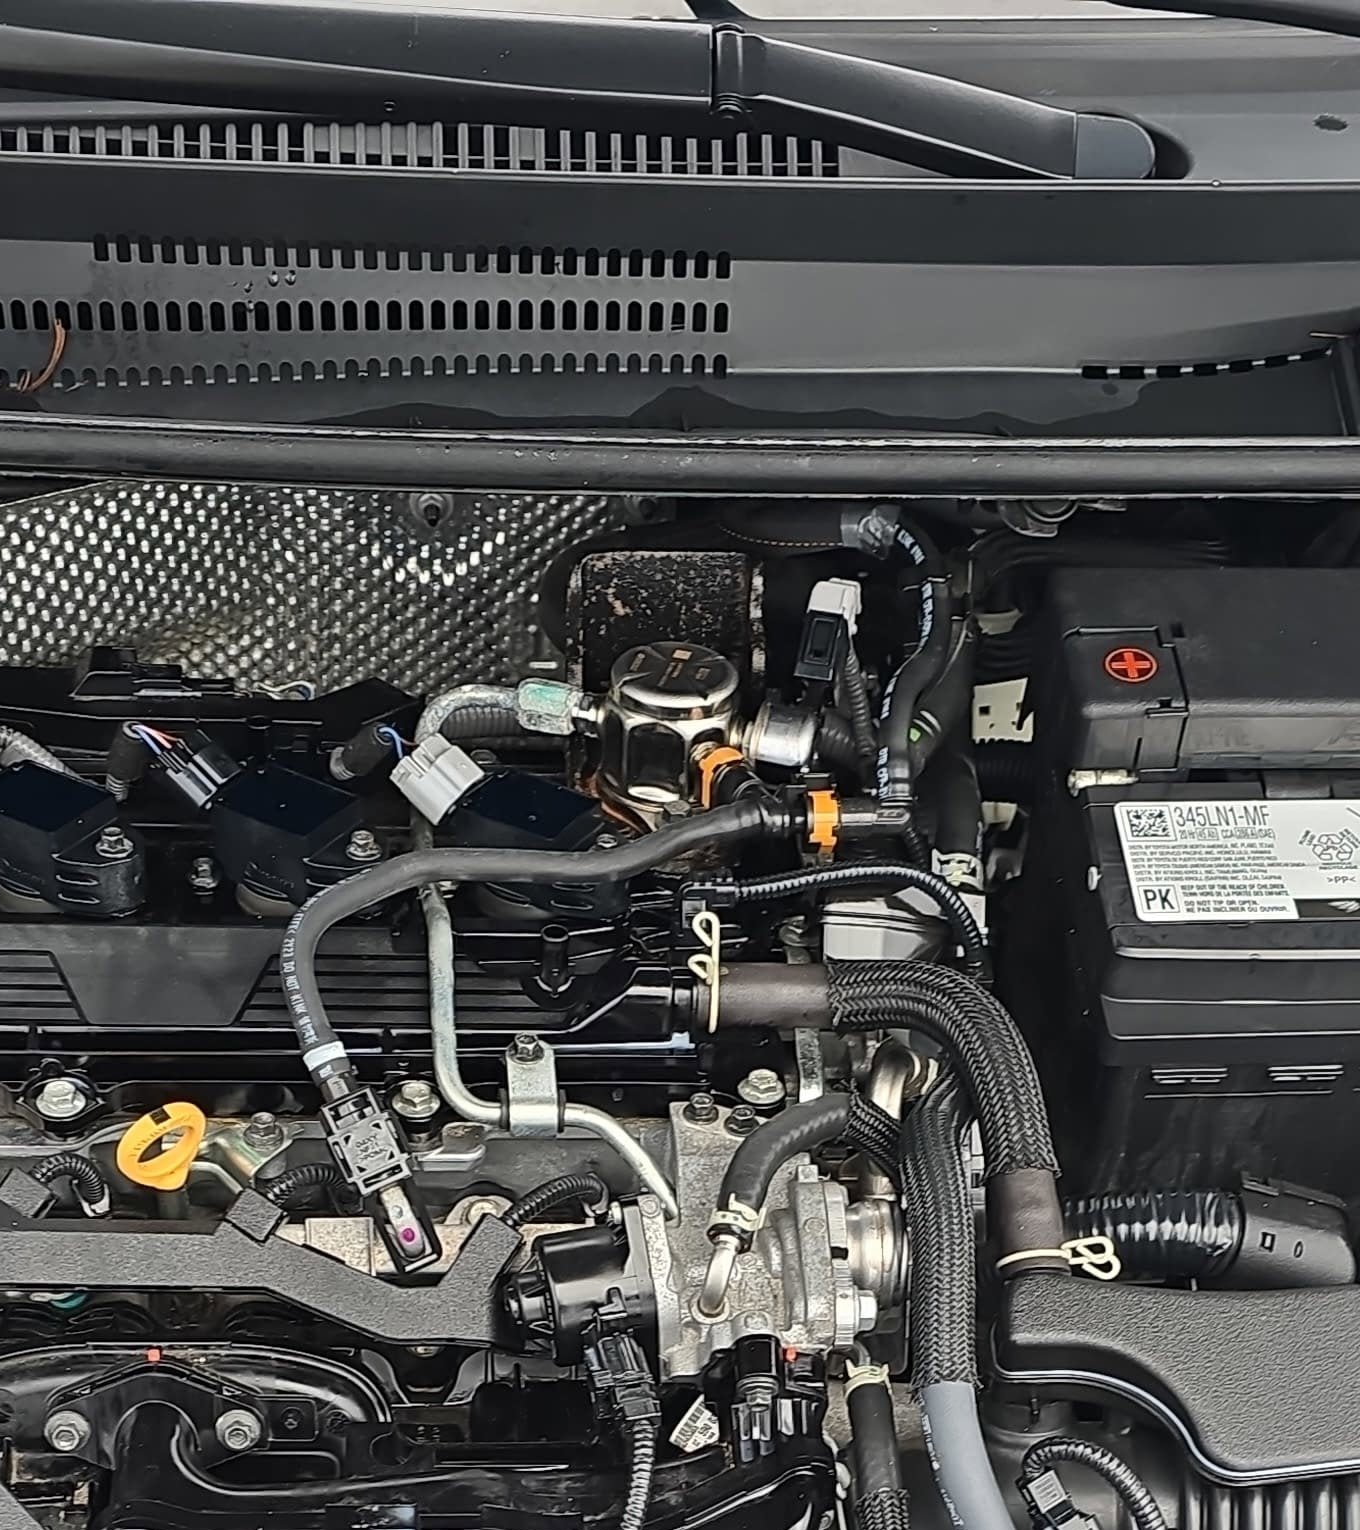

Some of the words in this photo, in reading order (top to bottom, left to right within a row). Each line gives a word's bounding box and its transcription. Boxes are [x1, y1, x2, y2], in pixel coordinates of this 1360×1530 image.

[1174, 805, 1270, 827] 345LN1-MF
[1143, 889, 1175, 910] PK
[286, 975, 300, 991] NOT
